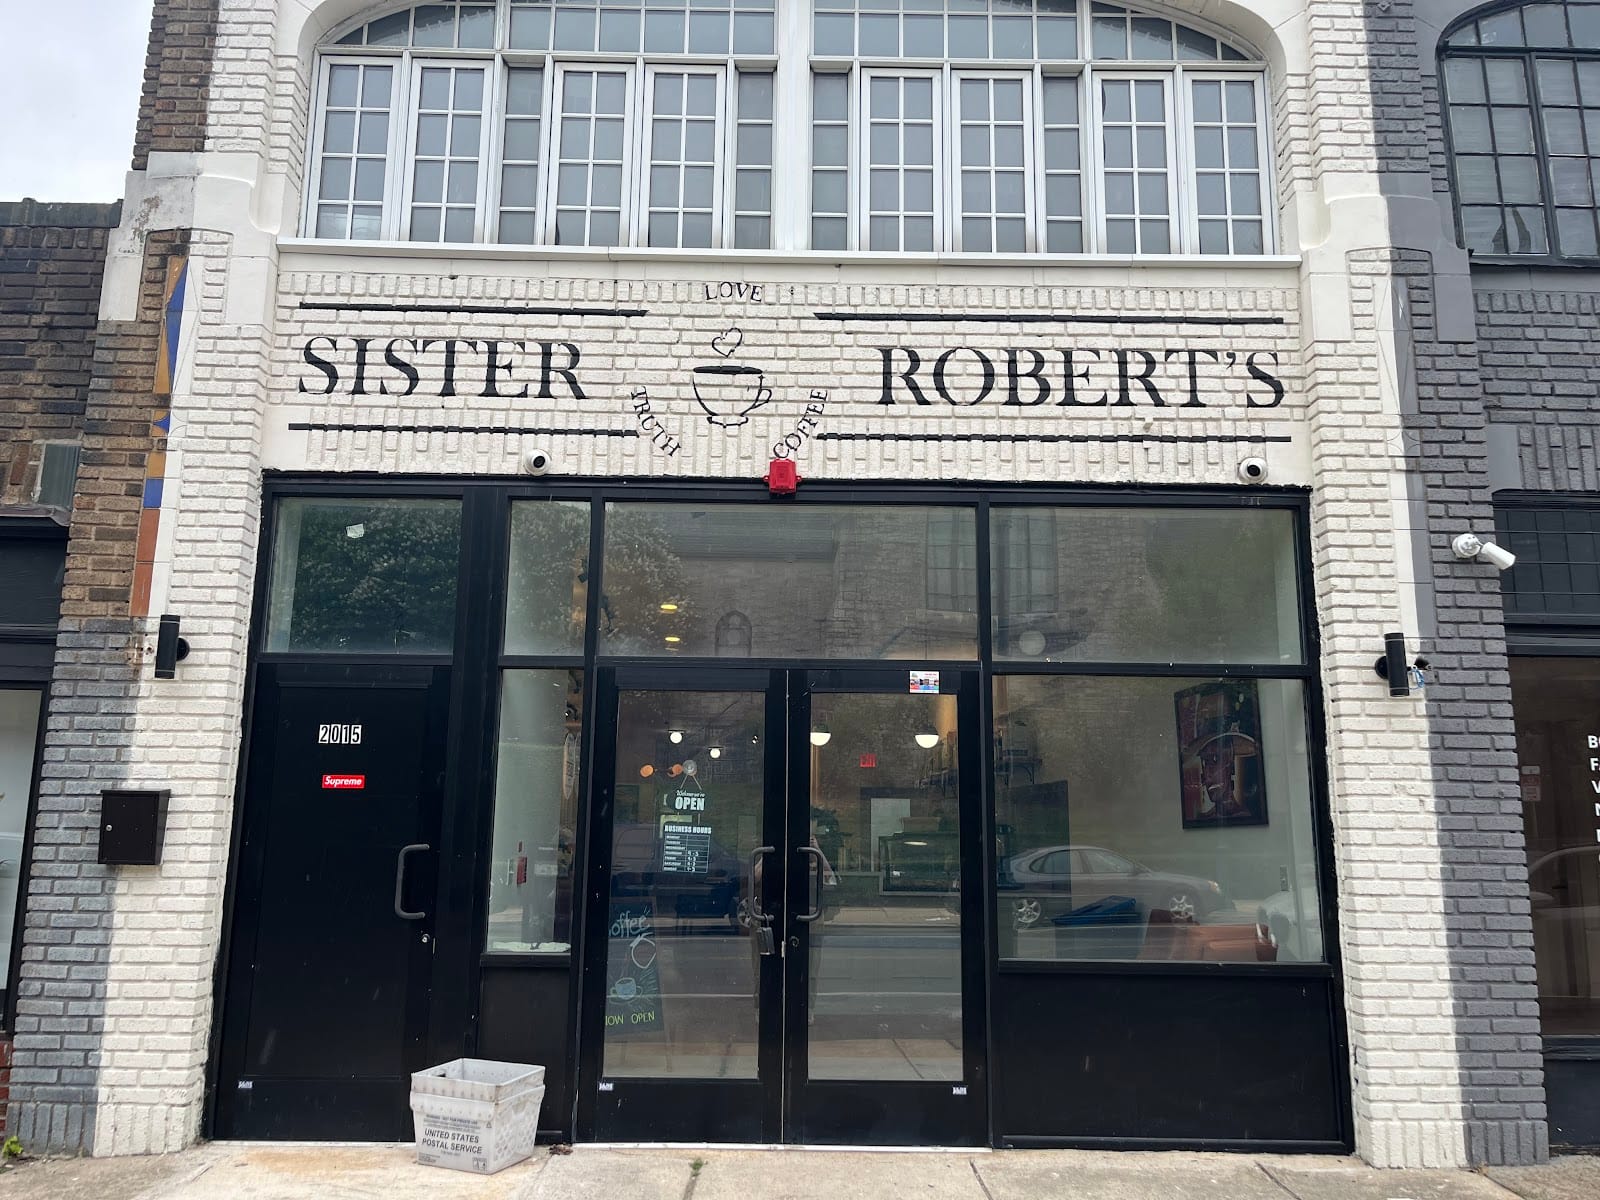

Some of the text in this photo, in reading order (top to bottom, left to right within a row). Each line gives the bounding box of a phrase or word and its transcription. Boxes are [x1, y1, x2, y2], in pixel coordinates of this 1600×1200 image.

[705, 281, 763, 303] LOVE
[298, 335, 1286, 409] SISTER ROBERT'S
[630, 385, 682, 457] TRUTH
[773, 388, 828, 459] COFFEE
[319, 724, 361, 744] 2015
[324, 775, 363, 787] Supreme
[675, 796, 705, 811] OPEN
[664, 824, 712, 834] BUSINESS HOURS
[609, 910, 651, 938] offee
[631, 1010, 655, 1024] OPEN
[424, 1127, 480, 1144] UNITED STATES
[422, 1138, 449, 1150] POSTAL
[450, 1143, 483, 1154] SERVICE
